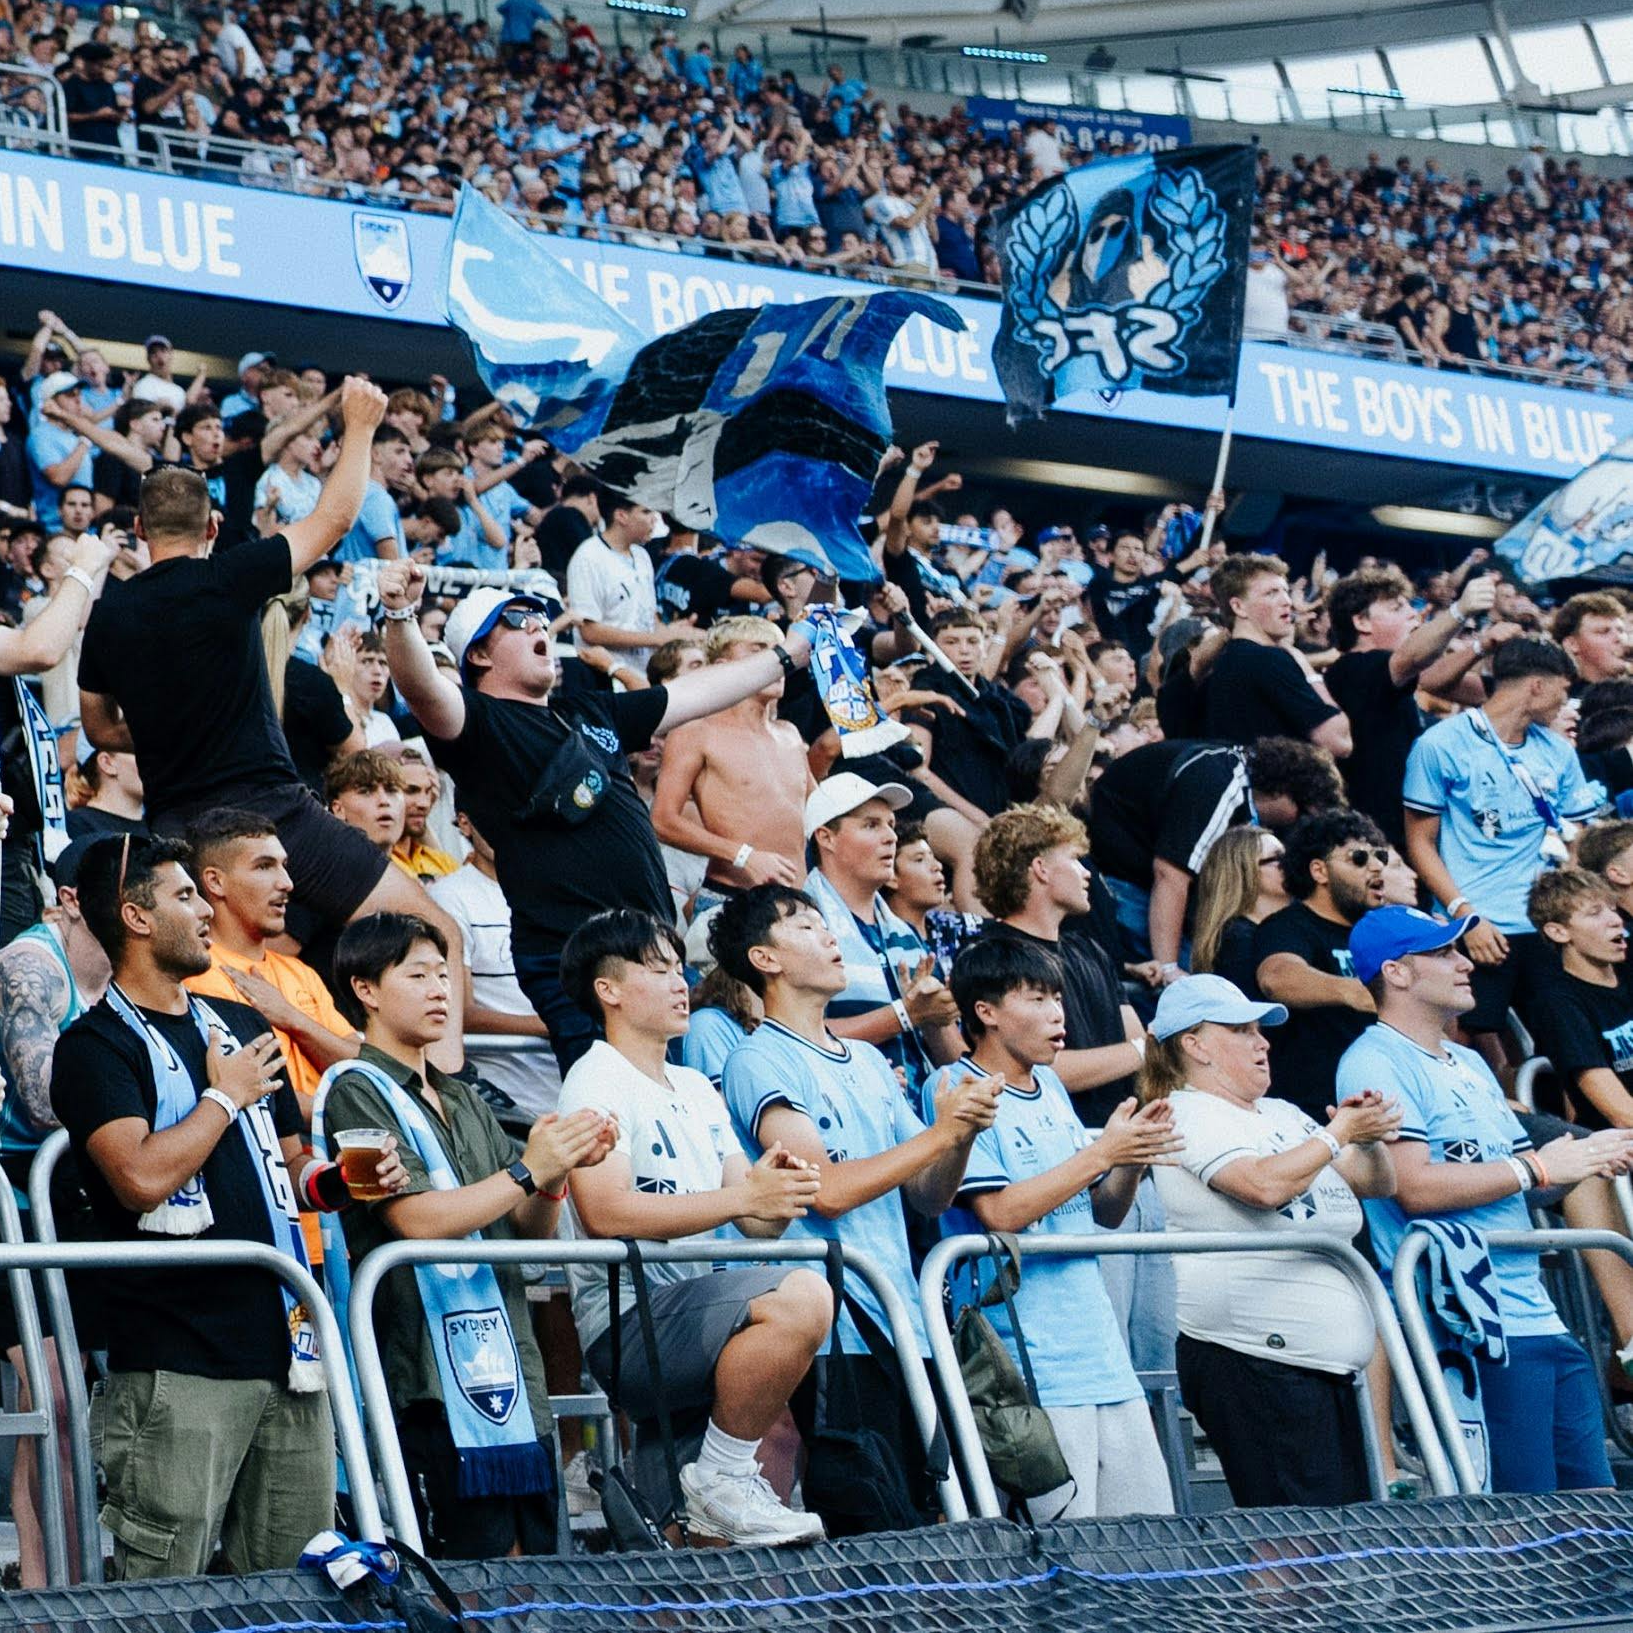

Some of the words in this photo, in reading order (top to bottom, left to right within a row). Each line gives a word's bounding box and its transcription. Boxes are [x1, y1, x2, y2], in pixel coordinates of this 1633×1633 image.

[83, 185, 241, 277] BLUE
[1258, 362, 1349, 432] THE
[1353, 376, 1463, 450] BOYS
[1467, 393, 1515, 455] IN
[449, 1317, 498, 1336] SYDNEY
[475, 1332, 488, 1343] FC
